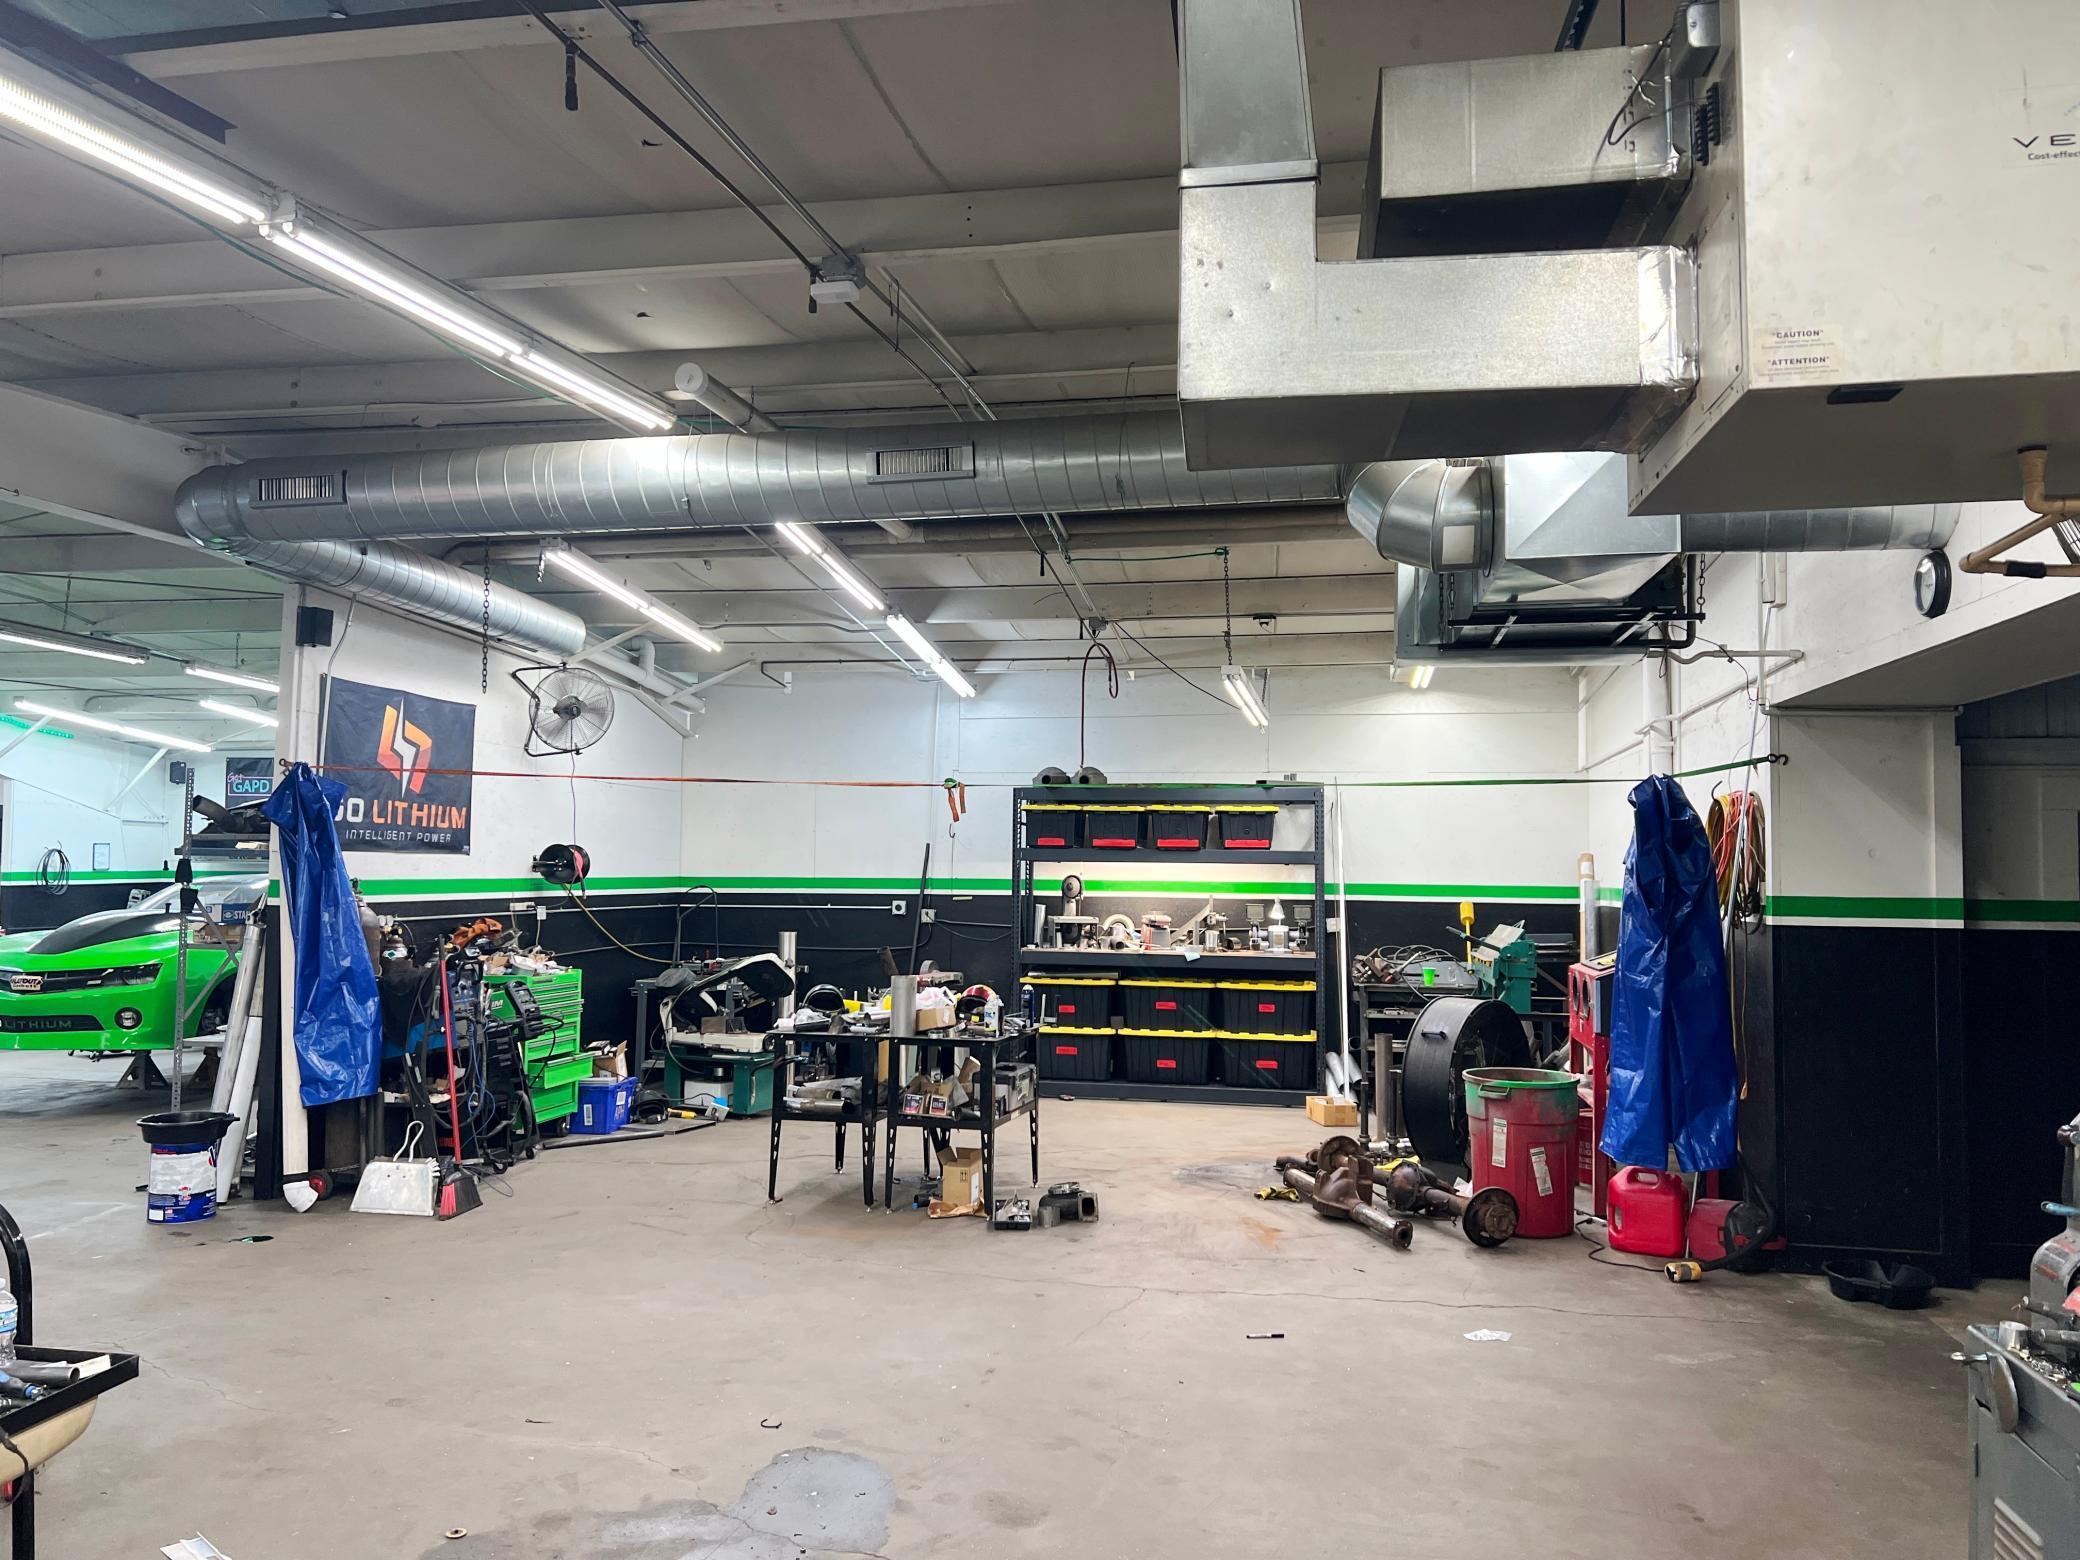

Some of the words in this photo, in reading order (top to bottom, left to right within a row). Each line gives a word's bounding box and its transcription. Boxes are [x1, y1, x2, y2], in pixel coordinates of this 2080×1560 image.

[233, 779, 270, 793] GAPD
[372, 799, 467, 829] LITHIUM
[345, 829, 412, 842] INTELLIGENT
[416, 832, 452, 843] POWER
[4, 1019, 72, 1029] LITHIUM
